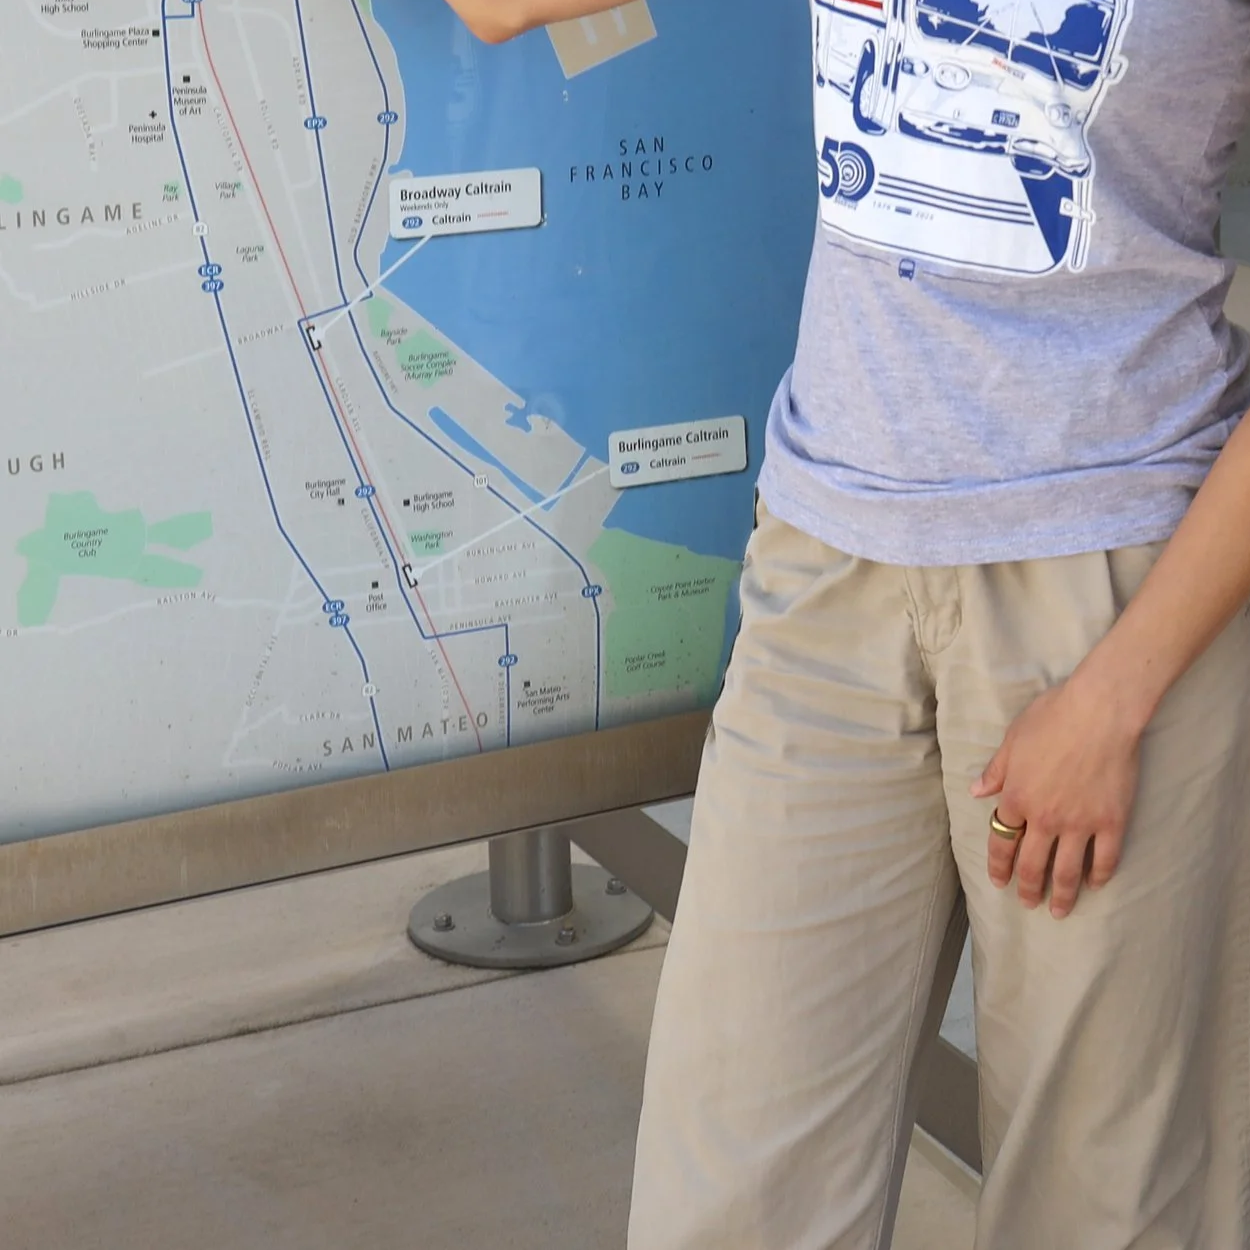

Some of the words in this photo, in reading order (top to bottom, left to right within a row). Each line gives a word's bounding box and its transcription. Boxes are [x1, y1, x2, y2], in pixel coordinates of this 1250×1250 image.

[41, 4, 59, 14] High
[62, 2, 89, 12] School
[81, 29, 126, 41] Burlingame
[129, 28, 149, 36] Plaza
[83, 38, 120, 49] Shopping
[123, 37, 148, 47] Center
[172, 87, 207, 95] Peninsula
[174, 97, 206, 105] Museum
[179, 106, 187, 115] of
[189, 106, 201, 115] Art
[307, 118, 324, 129] EPX
[380, 113, 395, 123] 292
[129, 124, 166, 133] Peninsula
[131, 133, 164, 144] Hospital
[619, 136, 664, 156] SAN
[570, 154, 713, 183] FRANCISCO
[820, 136, 875, 201] 50
[215, 181, 241, 192] Village
[400, 186, 461, 201] Broadway
[465, 181, 511, 196] Caltrain
[621, 181, 664, 201] BAY
[162, 193, 179, 203] Park
[220, 190, 236, 200] Park
[400, 202, 432, 212] Weekends
[434, 201, 449, 209] Only
[405, 218, 420, 227] 292
[432, 213, 471, 225] Caltrain
[236, 245, 264, 255] Laguna
[242, 254, 258, 262] Park
[201, 266, 219, 276] ECR
[381, 327, 407, 338] Bayside
[408, 351, 449, 362] Burlingame
[401, 362, 425, 372] Soccer
[426, 359, 457, 370] Complex
[618, 432, 683, 453] Burlingame
[686, 427, 729, 445] Caltrain
[7, 452, 66, 475] UGH
[623, 463, 638, 473] 292
[649, 455, 686, 469] Caltrain
[305, 478, 346, 490] Burlingame
[310, 490, 325, 500] City
[326, 487, 340, 497] Hall
[357, 486, 373, 496] 292
[413, 491, 453, 502] Burlingame
[413, 502, 430, 512] High
[431, 499, 454, 509] School
[63, 527, 108, 541] Burlingame
[411, 530, 453, 543] Washington
[71, 538, 102, 550] Country
[425, 541, 440, 550] Park
[78, 548, 96, 558] Club
[368, 593, 384, 602] Post
[325, 602, 341, 612] ECR
[366, 602, 387, 612] Office
[331, 616, 347, 626] 397
[500, 656, 515, 666] 292
[525, 687, 538, 697] San
[540, 685, 562, 696] Mateo
[517, 696, 554, 708] Performing
[557, 693, 570, 702] Arts
[533, 704, 555, 715] Center
[323, 732, 375, 757] SAN
[397, 711, 488, 743] MATEO
